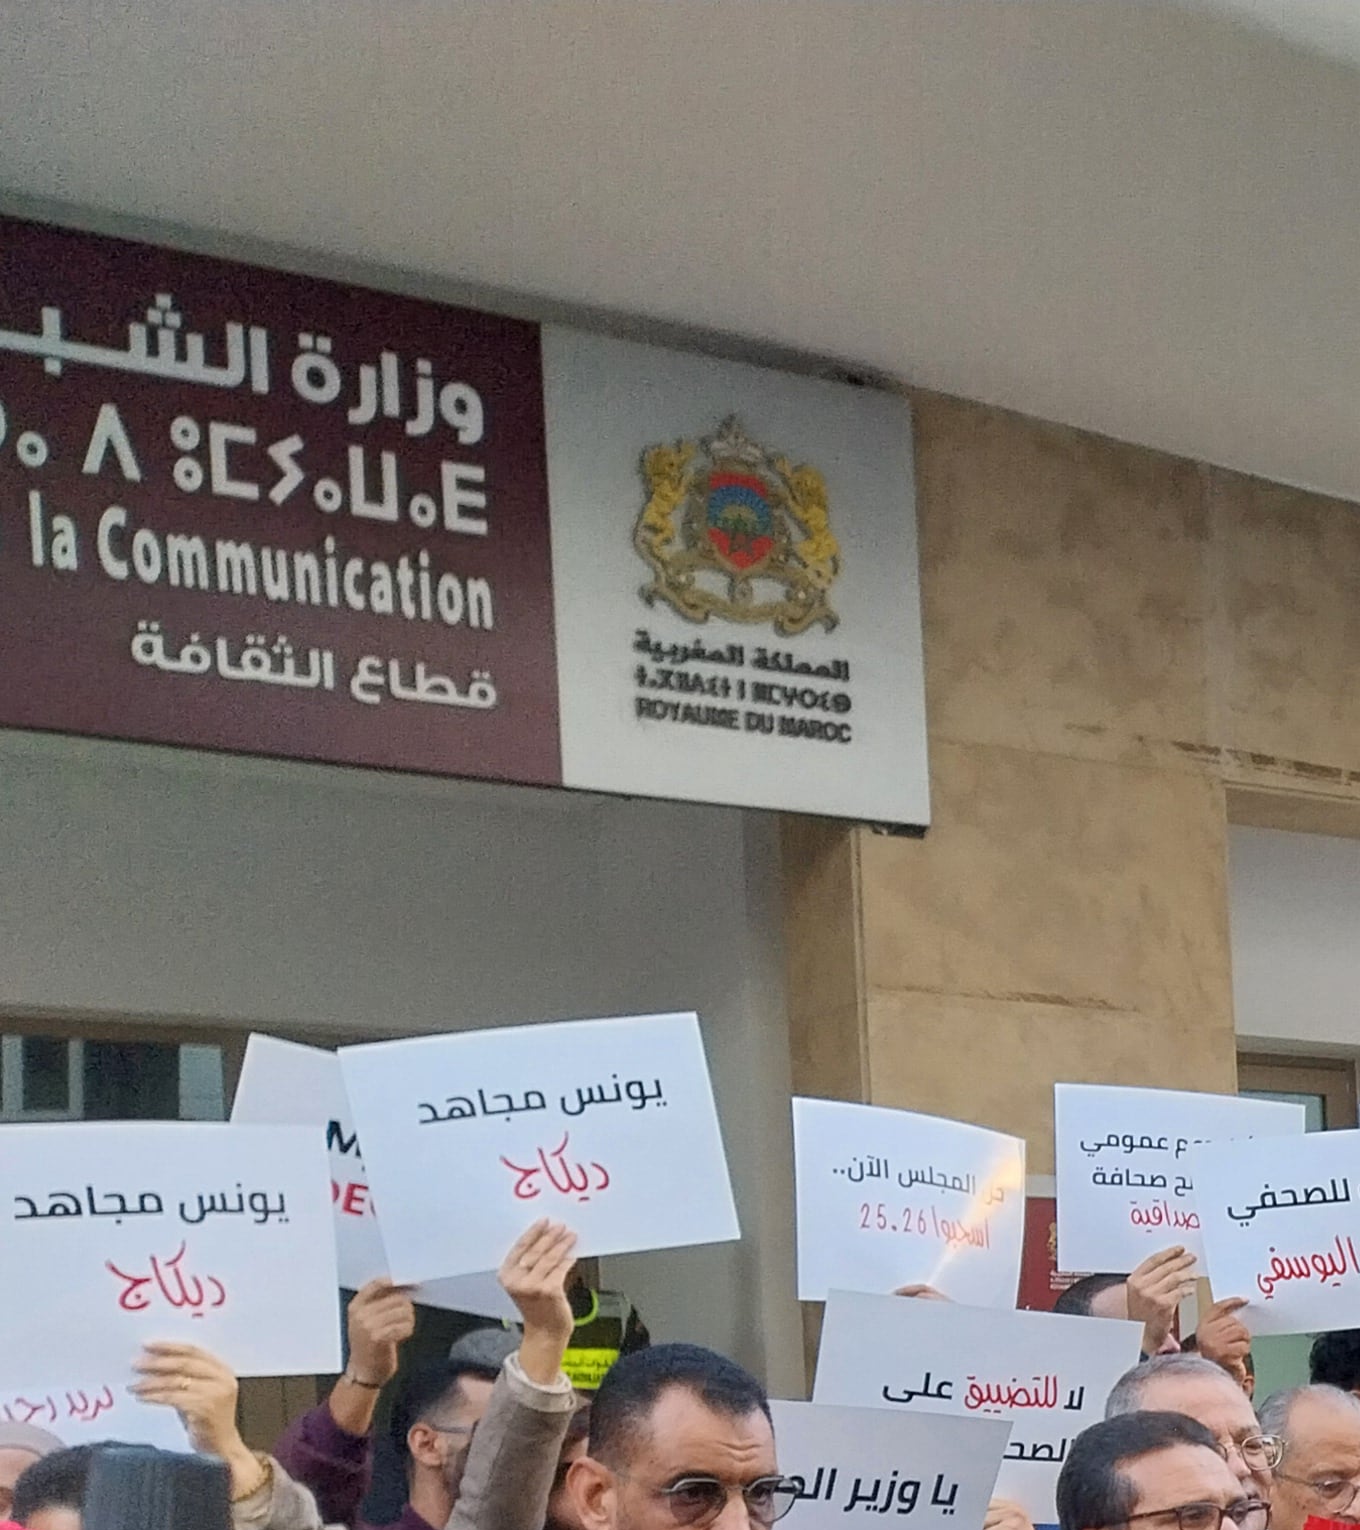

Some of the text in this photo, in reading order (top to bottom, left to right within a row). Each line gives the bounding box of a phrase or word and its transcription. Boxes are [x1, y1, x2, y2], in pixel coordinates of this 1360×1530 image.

[291, 331, 484, 444] وزارة
[29, 490, 494, 630] la Communication
[130, 620, 497, 709] قطاع الثقافة
[750, 647, 850, 682] المملكة
[635, 697, 852, 744] ROYAUME DU MAROC
[418, 1073, 668, 1125] يونس مجاهد
[499, 1130, 610, 1202] ديكاج
[1080, 1132, 1168, 1158] عمومي
[898, 1165, 976, 1196] المجلس
[1092, 1166, 1168, 1189] صحافة
[14, 1183, 164, 1225] مجاهد
[180, 1182, 289, 1224] يونس
[858, 1202, 991, 1250] اسحبوا 25.26
[1227, 1178, 1350, 1228] للصحفي
[104, 1239, 227, 1318] ديكاج
[1256, 1234, 1360, 1299] اليوسفي
[882, 1372, 1086, 1414] لا للتضييق على
[844, 1470, 921, 1515] وزير
[930, 1473, 959, 1515] يا
